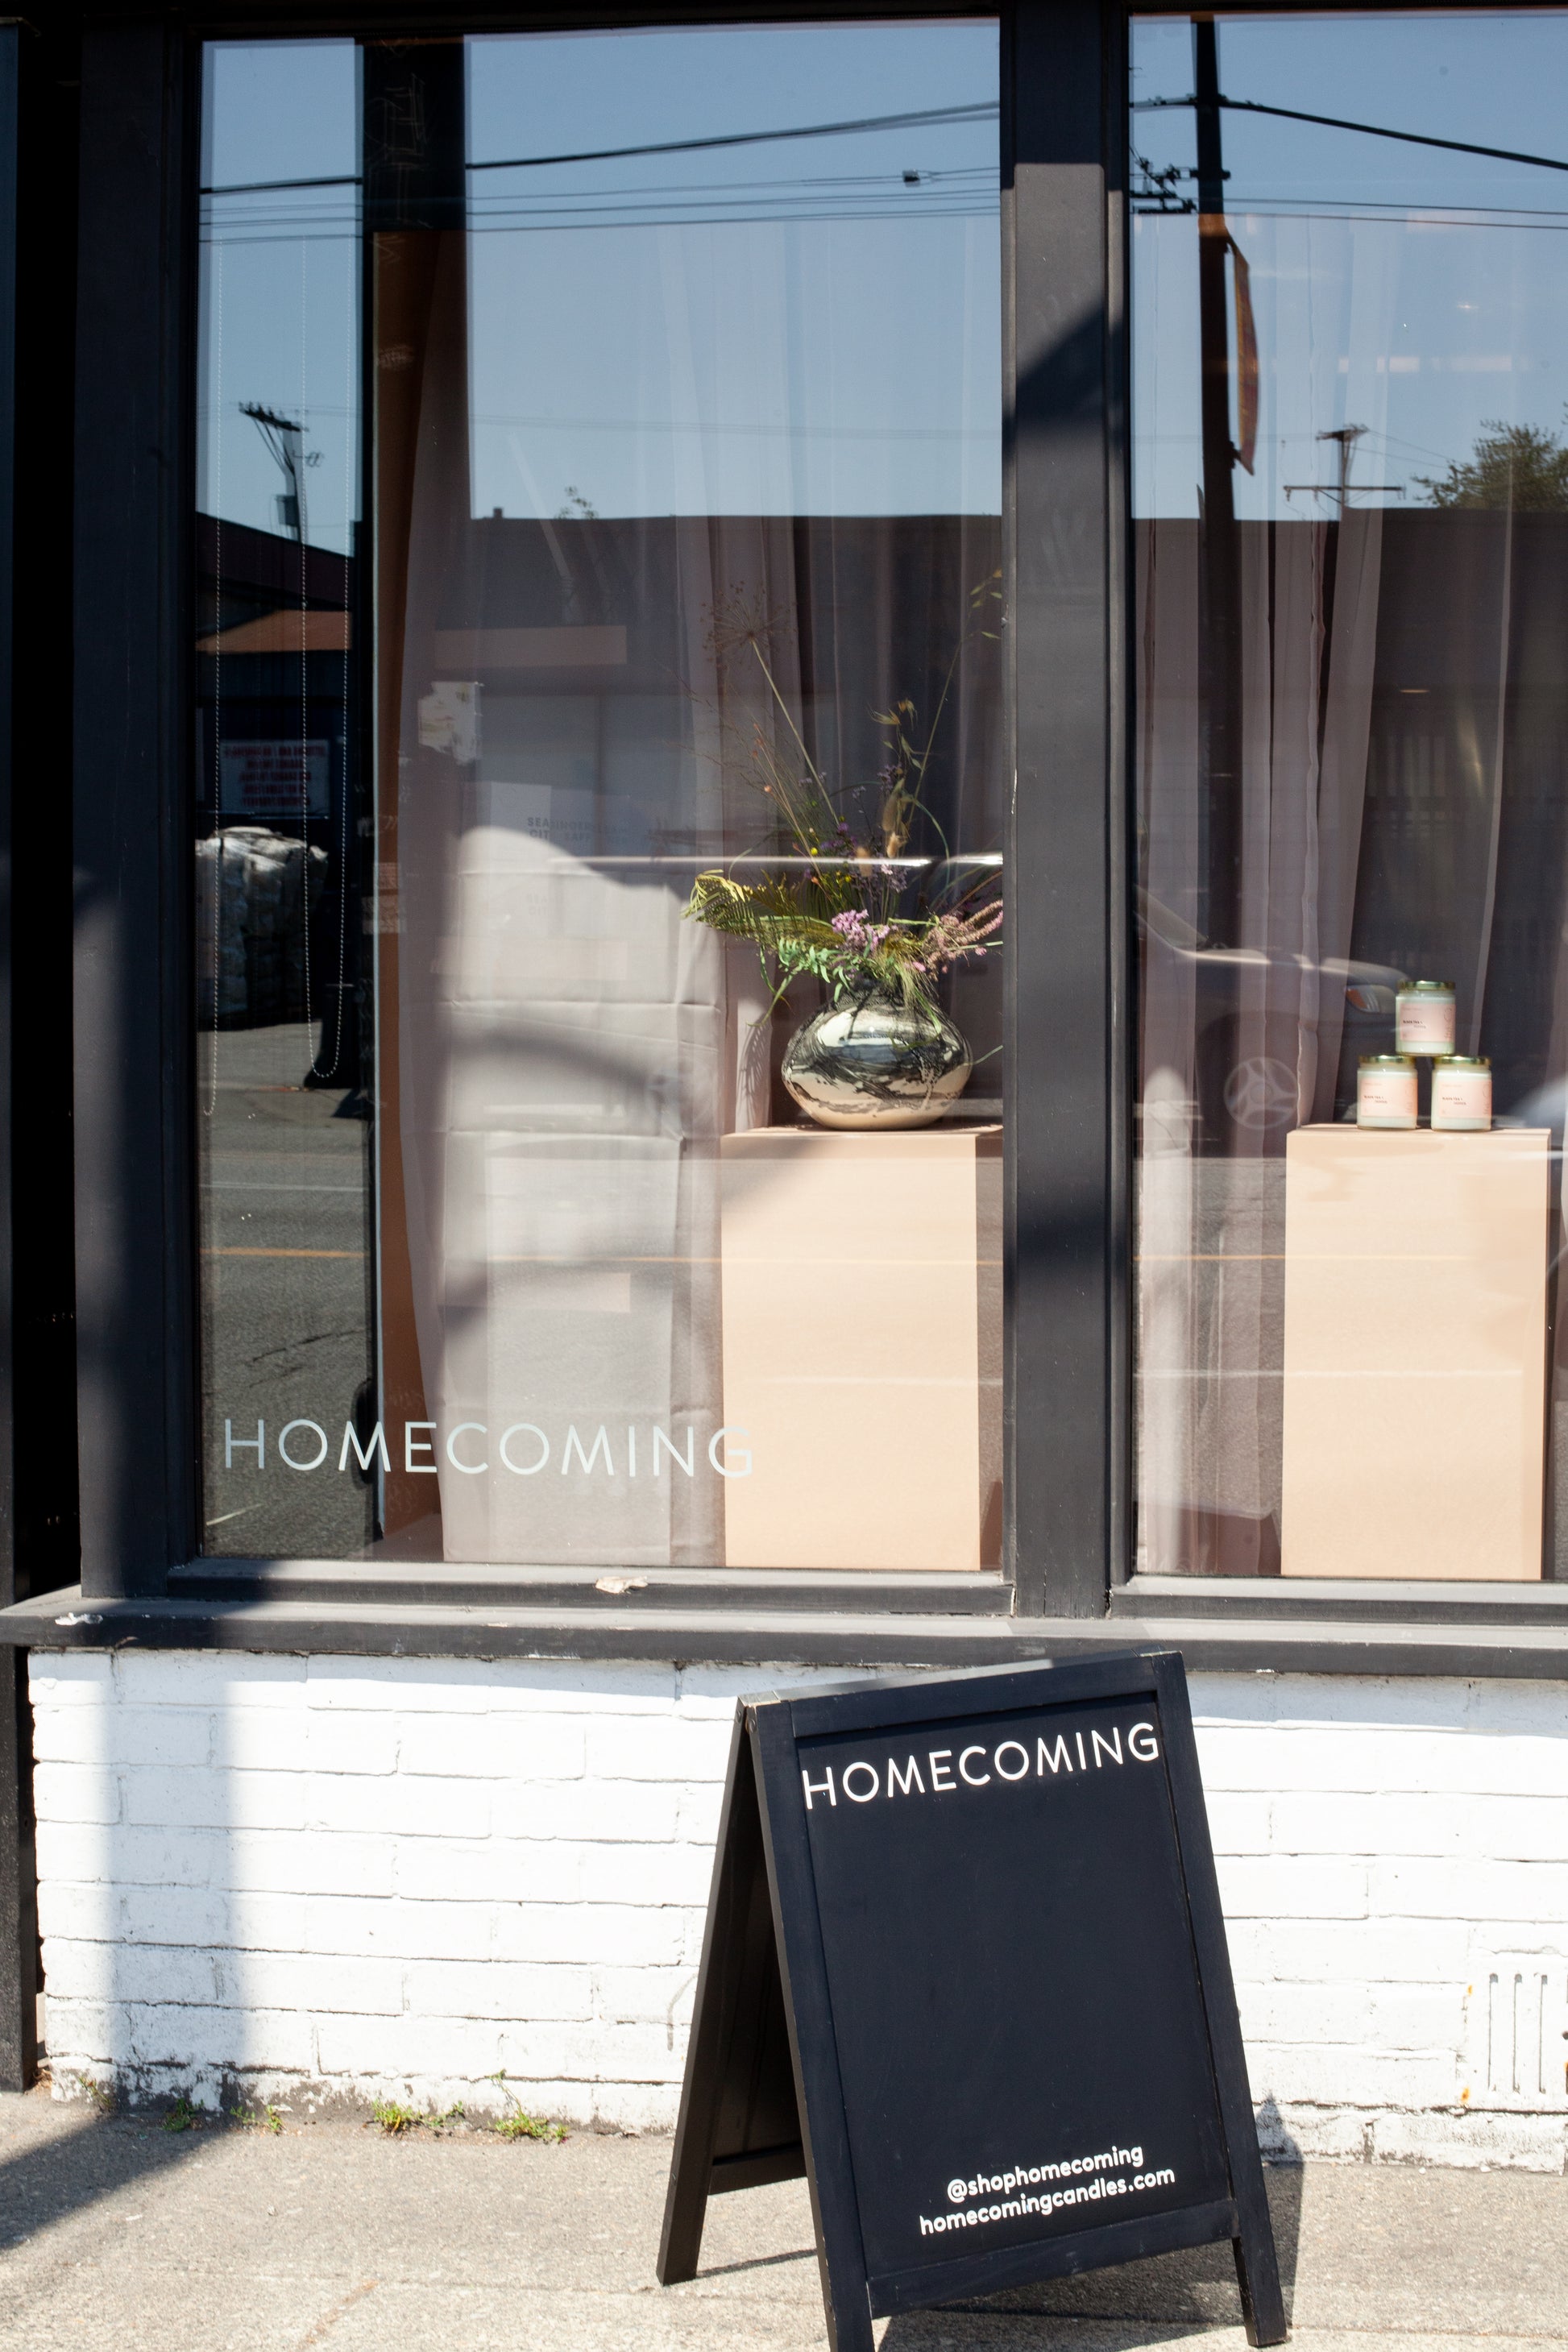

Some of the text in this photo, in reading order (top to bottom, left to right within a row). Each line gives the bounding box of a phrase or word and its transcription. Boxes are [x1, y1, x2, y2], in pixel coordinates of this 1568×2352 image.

[224, 1419, 753, 1478] HOMECOMING
[802, 1722, 1159, 1810] HOMECOMING
[919, 2168, 1175, 2235] homecomingcandles.com
[947, 2145, 1143, 2203] @shophomecoming
